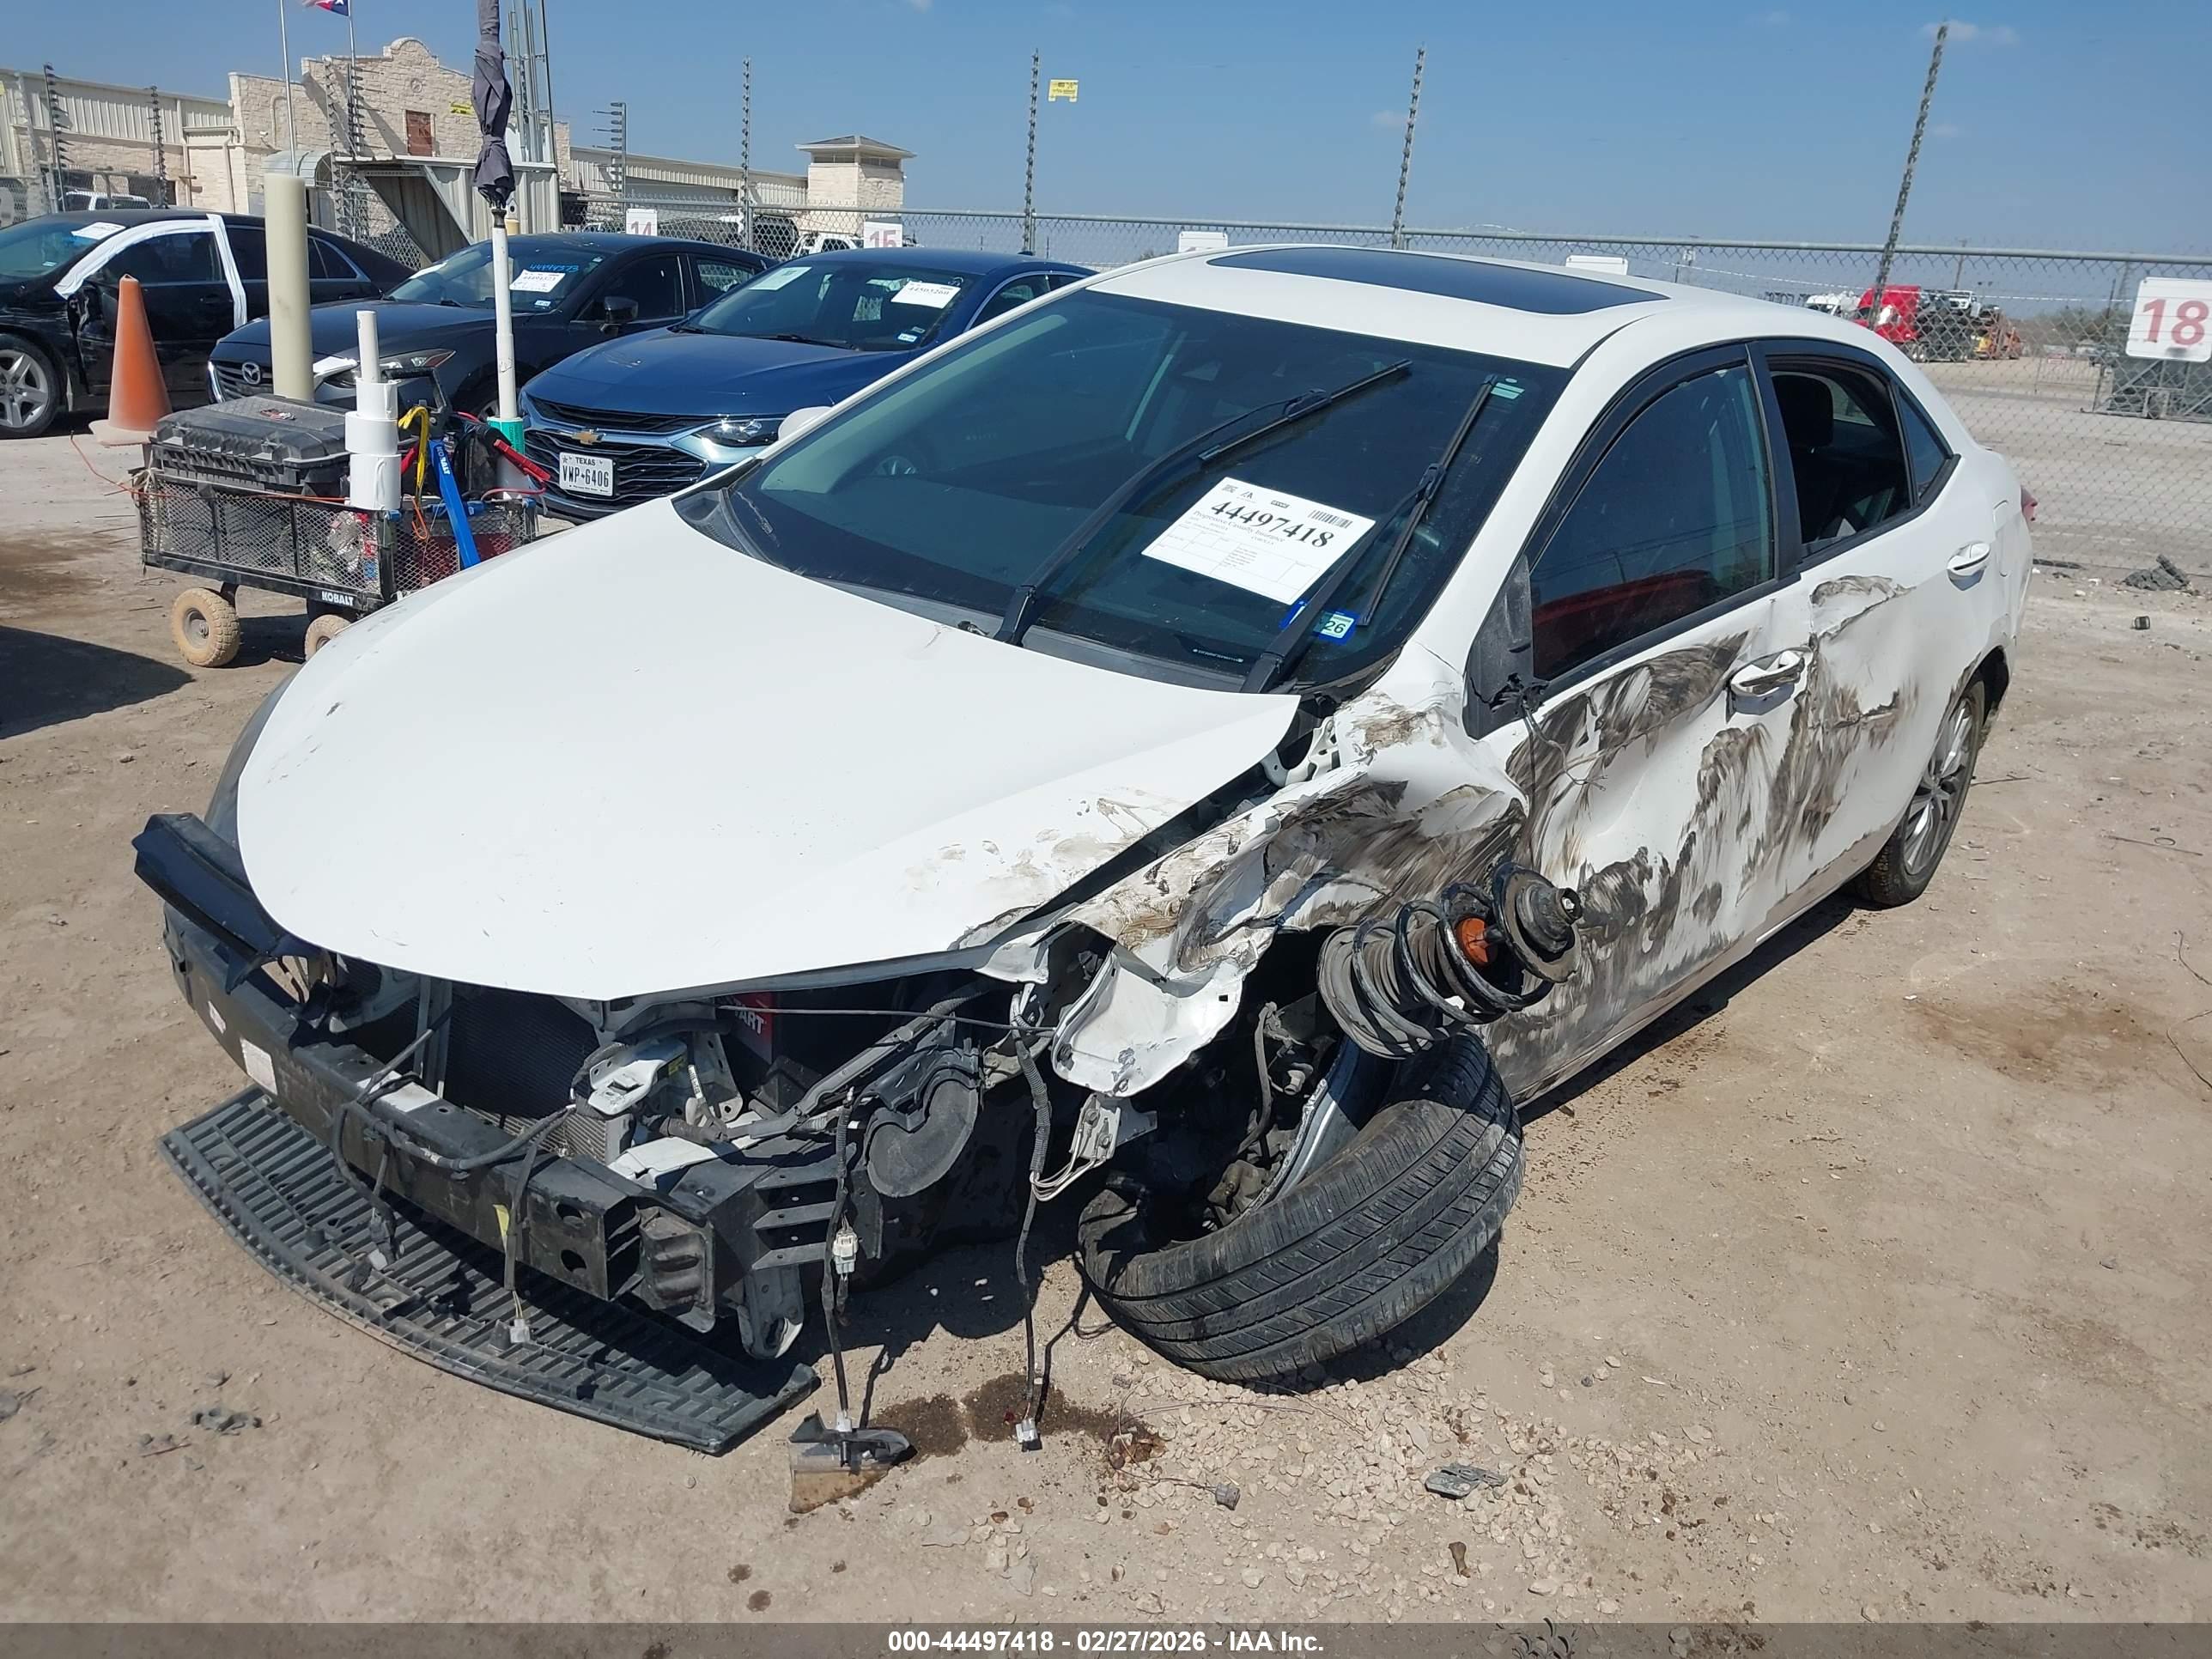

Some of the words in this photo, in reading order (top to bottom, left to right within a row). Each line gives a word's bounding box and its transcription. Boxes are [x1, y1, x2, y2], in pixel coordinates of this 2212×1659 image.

[2143, 299, 2209, 345] 18
[436, 446, 451, 475] KOBALT
[575, 457, 596, 465] TEXAS
[1211, 501, 1334, 548] 44497418
[321, 590, 354, 605] KOBALT
[1323, 621, 1346, 634] 26
